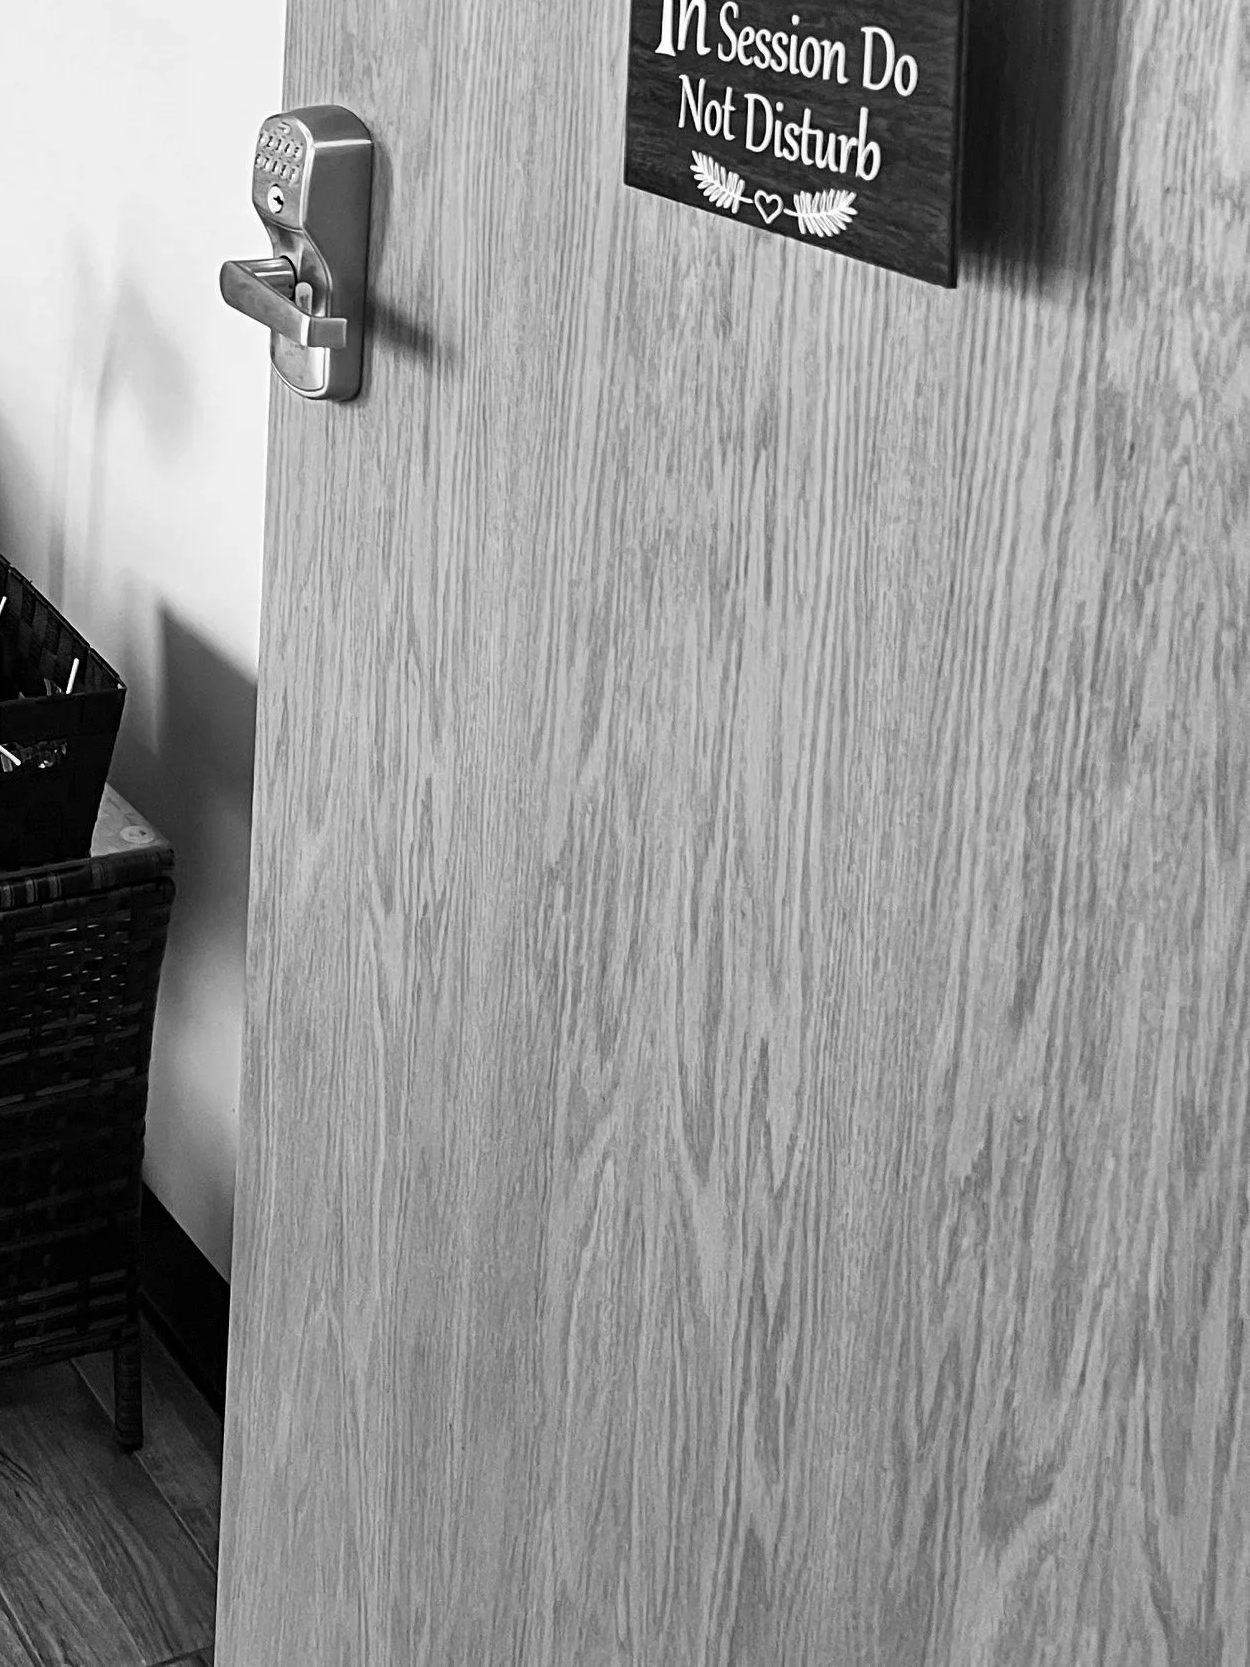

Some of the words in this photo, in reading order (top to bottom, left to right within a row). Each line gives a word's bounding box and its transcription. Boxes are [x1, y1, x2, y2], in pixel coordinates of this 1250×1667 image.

[717, 2, 849, 84] Session
[861, 26, 918, 97] Do
[678, 74, 735, 141] Not
[744, 93, 881, 181] Disturb
